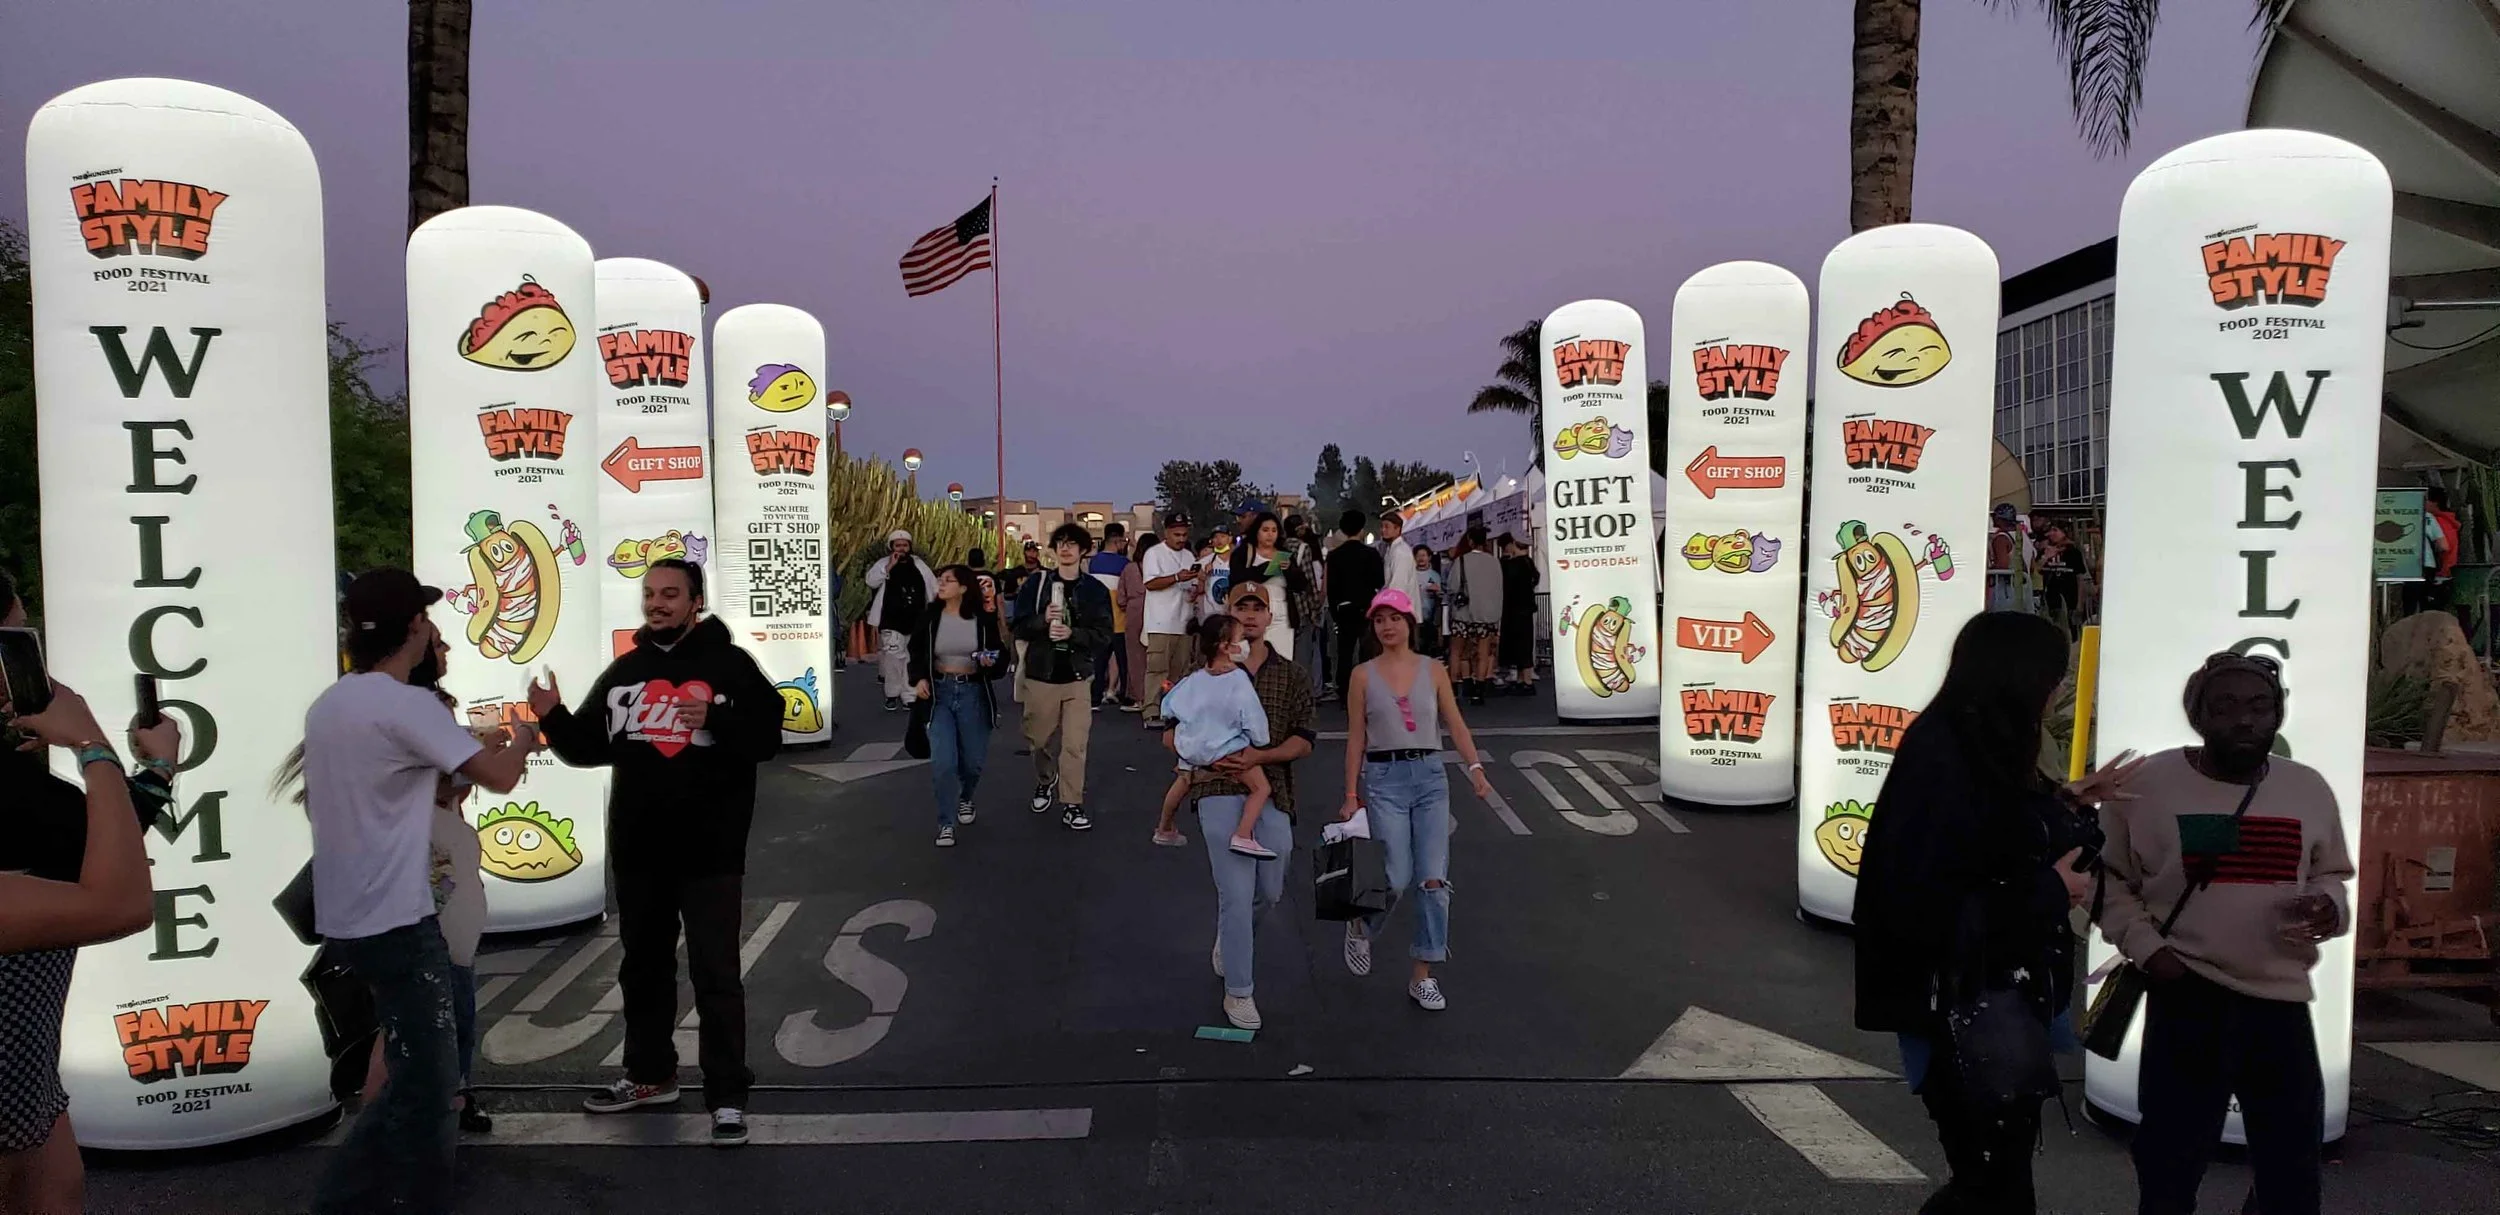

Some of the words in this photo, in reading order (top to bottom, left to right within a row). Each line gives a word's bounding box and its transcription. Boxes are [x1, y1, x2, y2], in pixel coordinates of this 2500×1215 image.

[70, 179, 230, 224] FAMILY
[81, 215, 211, 256] STYLE
[2201, 233, 2348, 275] FAMILY
[93, 268, 132, 281] FOOD
[141, 268, 210, 284] FESTIVAL
[127, 281, 168, 292] 2021
[2208, 267, 2330, 308] STYLE
[2219, 317, 2258, 332] FOOD
[2265, 316, 2326, 329] FESTIVAL
[2252, 329, 2289, 339] 2021
[597, 330, 695, 360] FAMILY
[1553, 339, 1632, 368] FAMILY
[1693, 344, 1790, 372] FAMILY
[605, 356, 689, 385] STYLE
[1557, 361, 1623, 387] STYLE
[1696, 368, 1780, 398] STYLE
[616, 395, 645, 406] FOOD
[651, 395, 690, 405] FESTIVAL
[1563, 393, 1584, 403] FOOD
[1587, 392, 1624, 400] FESTIVAL
[641, 404, 668, 413] 2021
[1702, 407, 1729, 417] FOOD
[1733, 407, 1776, 418] FESTIVAL
[477, 408, 573, 436] FAMILY
[1723, 416, 1750, 425] 2021
[745, 431, 820, 455] FAMILY
[1843, 419, 1936, 449] FAMILY
[485, 432, 564, 458] STYLE
[628, 458, 665, 471] GIFT
[668, 456, 701, 470] SHOP
[751, 451, 815, 475] STYLE
[1845, 442, 1922, 471] STYLE
[494, 467, 521, 476] FOOD
[526, 466, 564, 476] FESTIVAL
[518, 475, 542, 483] 2021
[1706, 466, 1741, 478] GIFT
[1744, 466, 1783, 478] SHOP
[758, 480, 781, 489] FOOD
[784, 480, 815, 490] FESTIVAL
[1553, 475, 1634, 508] GIFT
[1848, 476, 1871, 484] FOOD
[1875, 477, 1916, 489] FESTIVAL
[1866, 485, 1889, 494] 2021
[763, 505, 786, 513] SCAN
[788, 505, 809, 513] HERE
[747, 522, 782, 534] GIFT
[786, 522, 820, 534] SHOP
[1554, 513, 1636, 541] SHOP
[1564, 545, 1612, 555] PRESENTED
[1614, 544, 1626, 552] BY
[1574, 556, 1638, 568] DOORDASH
[772, 632, 823, 640] DOORDASH
[1692, 624, 1743, 648] VIP
[1680, 689, 1776, 716] FAMILY
[1684, 712, 1765, 741] STYLE
[1828, 703, 1920, 731] FAMILY
[1711, 758, 1737, 766] 2021
[1720, 749, 1763, 760] FESTIVAL
[1837, 758, 1860, 766] FOOD
[1864, 759, 1891, 769] FESTI
[1855, 767, 1879, 776] 2021
[1440, 749, 1692, 836] TOP
[113, 1000, 270, 1046] FAMILY
[123, 1033, 253, 1080] STYLE
[136, 1090, 177, 1106] FOOD
[185, 1083, 252, 1099] FESTIVAL
[172, 1099, 211, 1114] 2021
